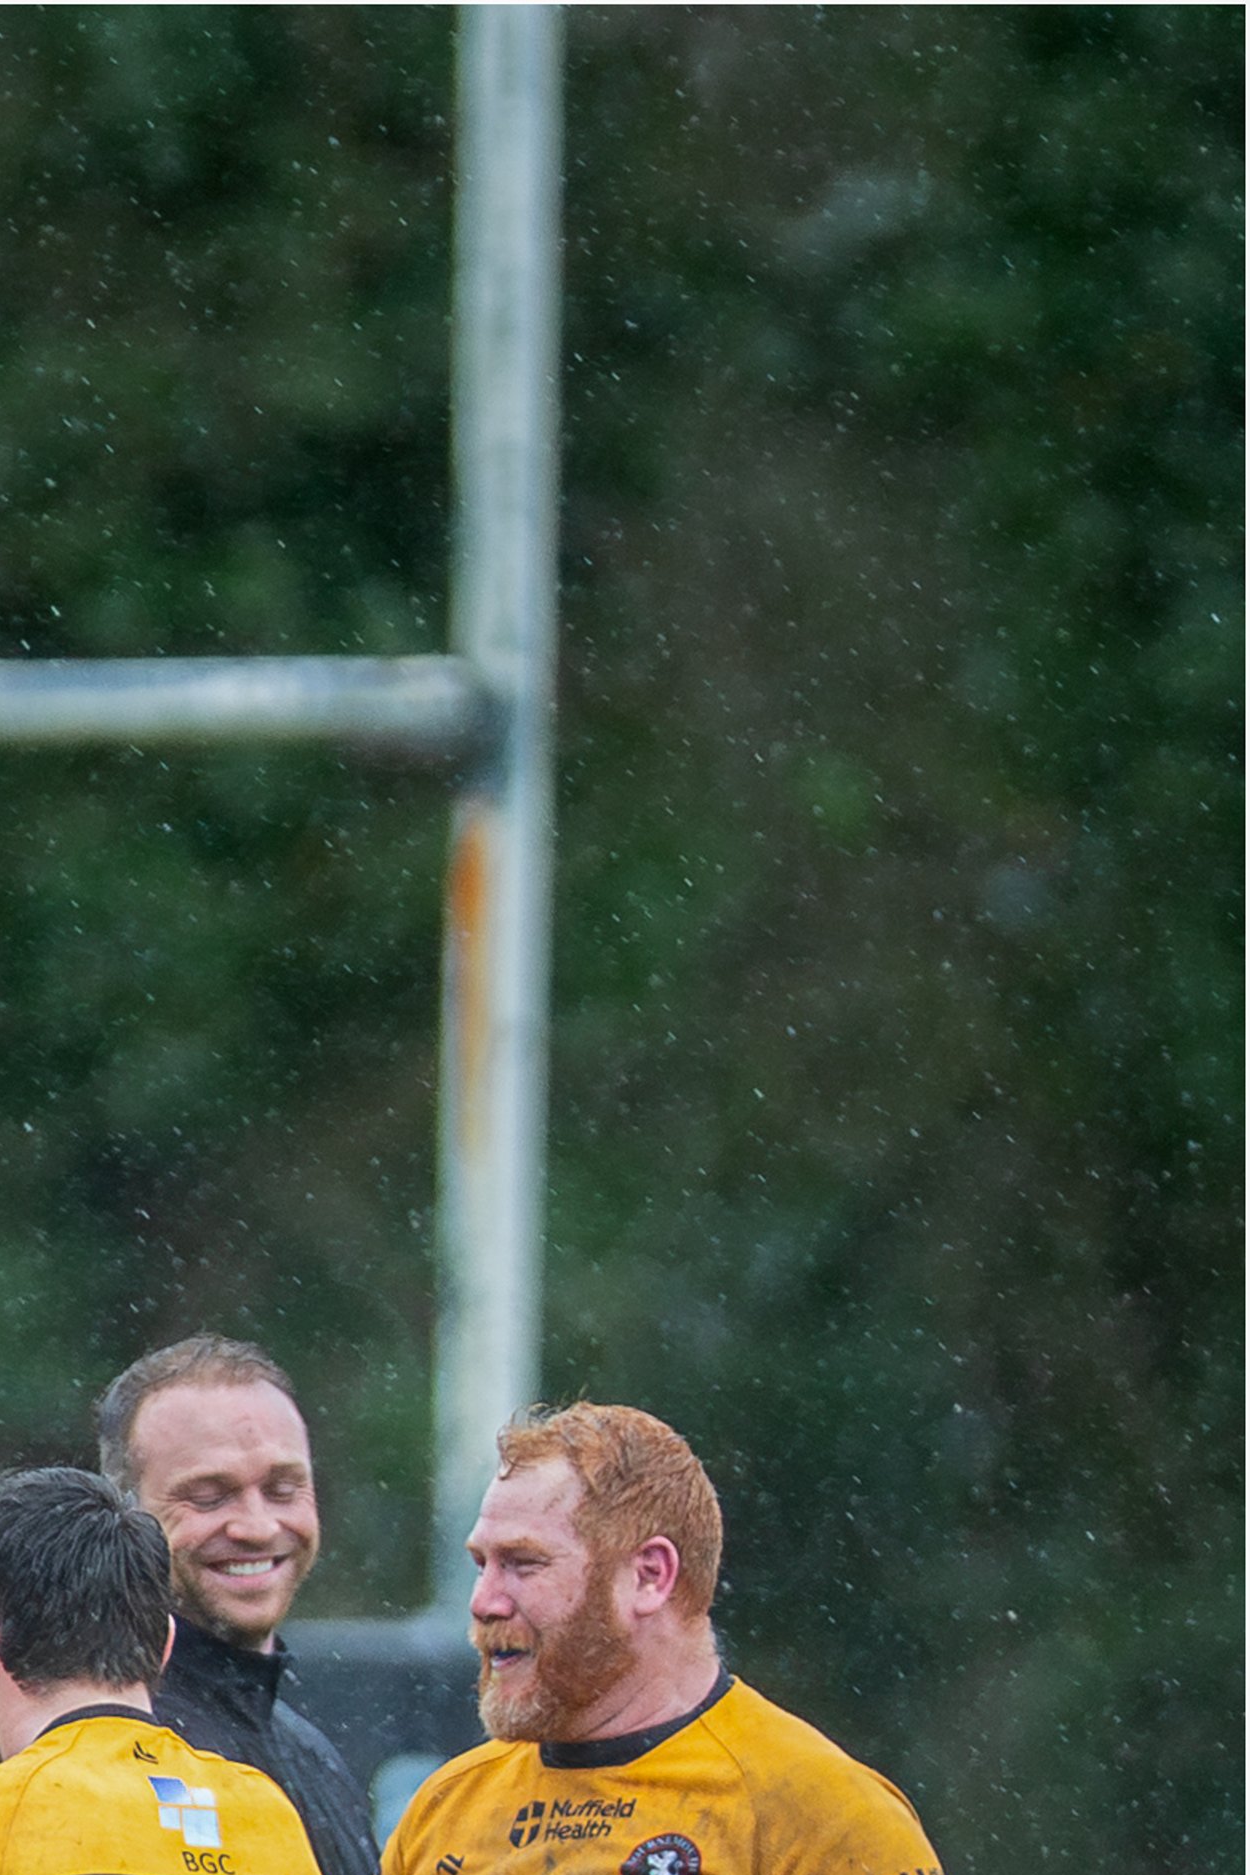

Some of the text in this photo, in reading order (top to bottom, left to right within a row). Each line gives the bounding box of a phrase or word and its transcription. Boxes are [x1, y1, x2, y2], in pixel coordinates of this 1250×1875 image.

[550, 1798, 637, 1819] Nuffield
[544, 1820, 612, 1843] Health
[182, 1851, 237, 1875] BGC
